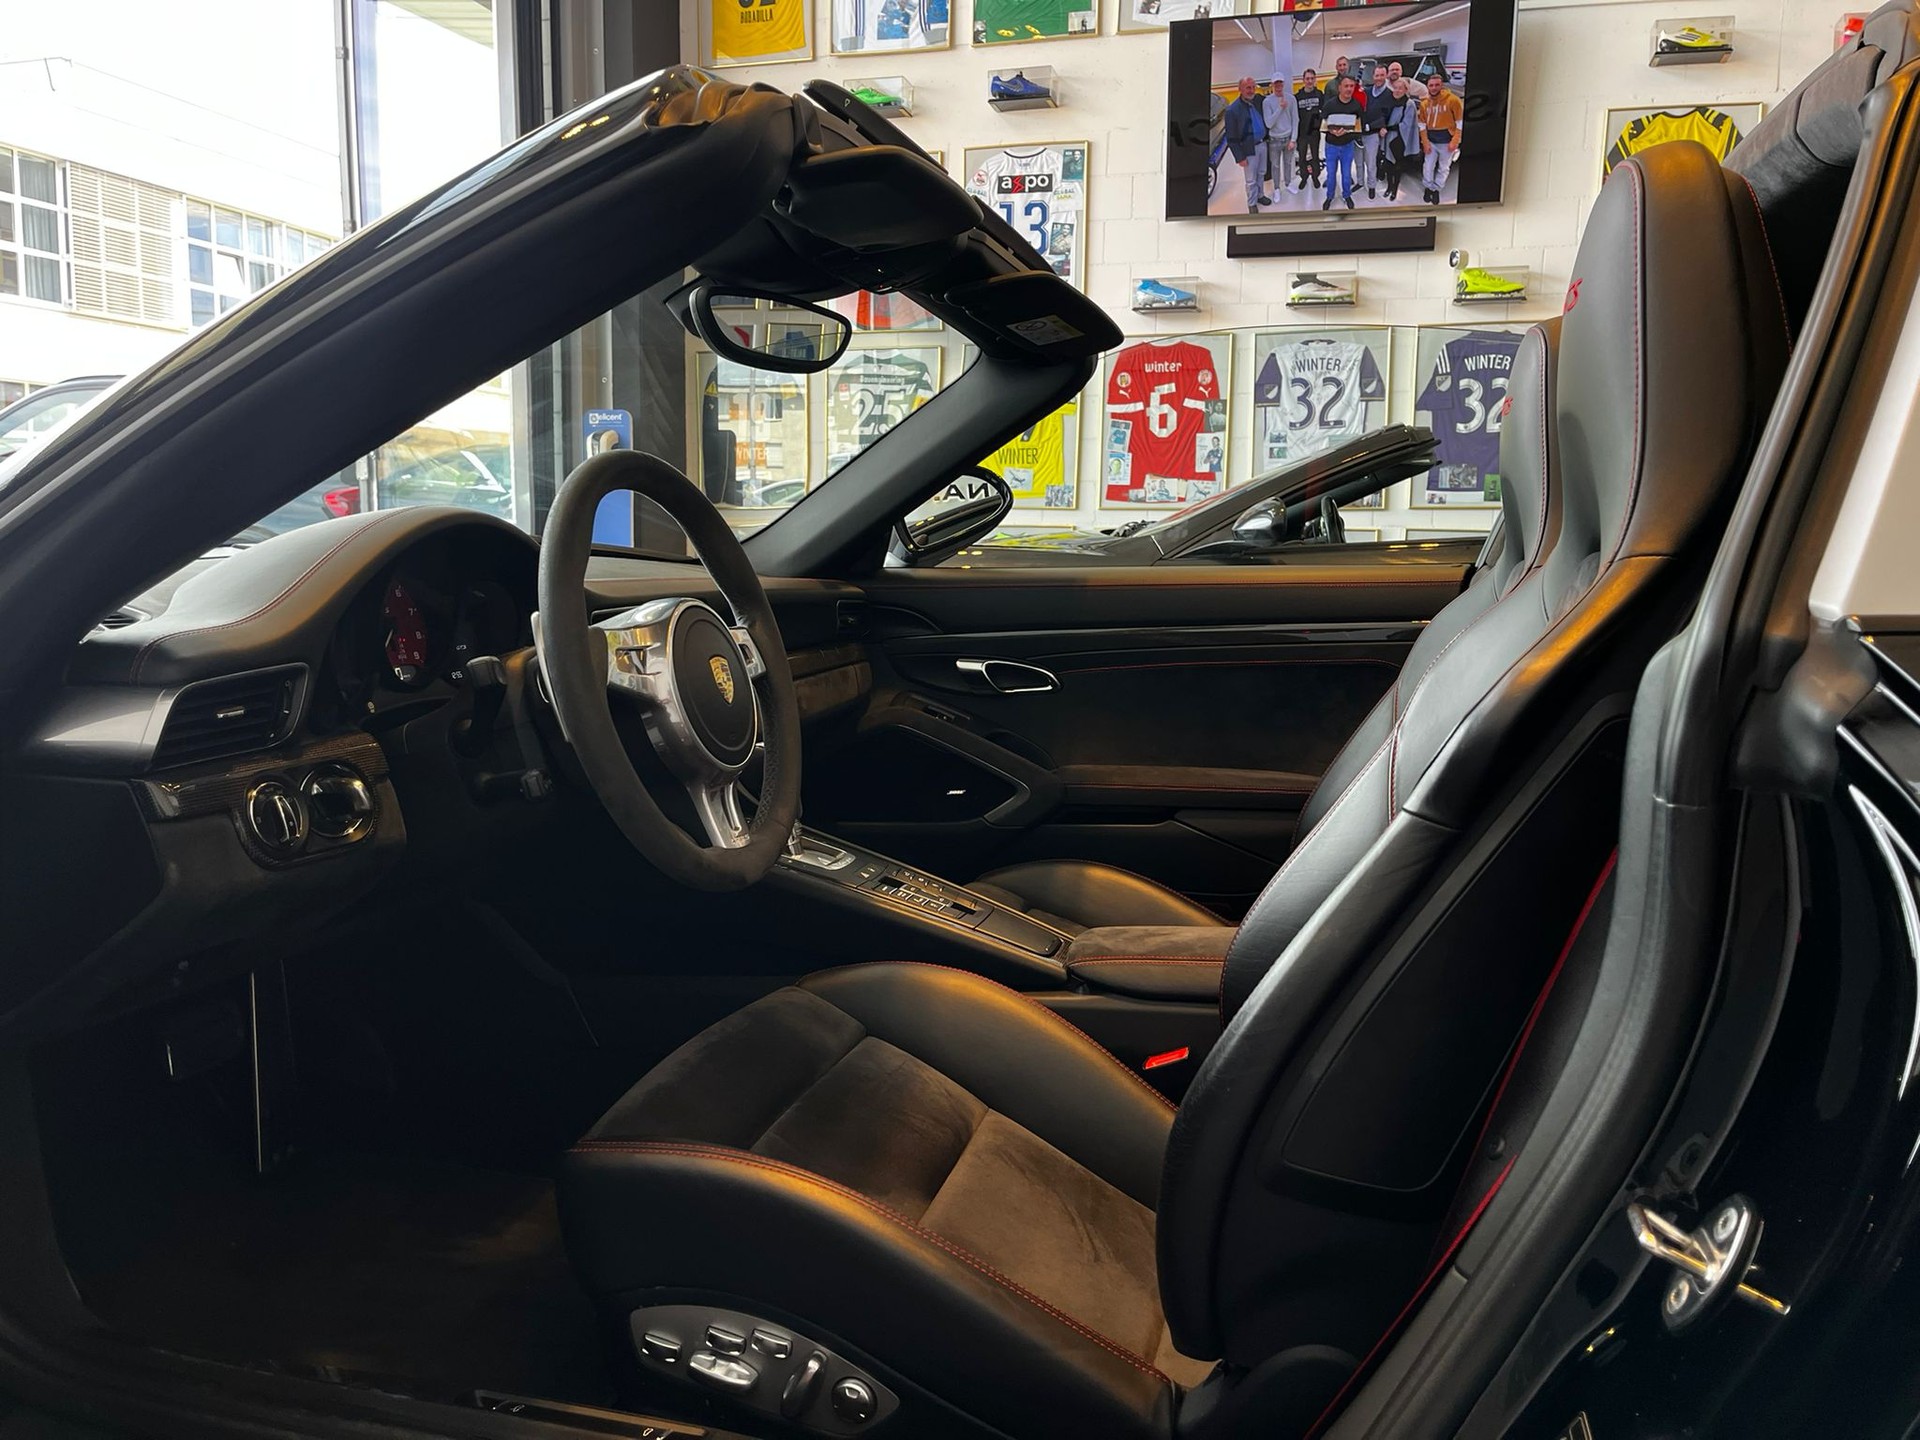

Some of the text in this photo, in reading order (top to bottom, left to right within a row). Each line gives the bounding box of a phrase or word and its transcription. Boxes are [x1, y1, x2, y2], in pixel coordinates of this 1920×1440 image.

[1144, 361, 1182, 373] winter
[1295, 357, 1342, 373] WINTER
[1464, 354, 1512, 372] WINTER
[851, 388, 906, 435] 25
[1146, 382, 1177, 438] 6
[1289, 376, 1347, 431] 32
[1456, 377, 1509, 433] 32
[998, 447, 1039, 465] WINTER
